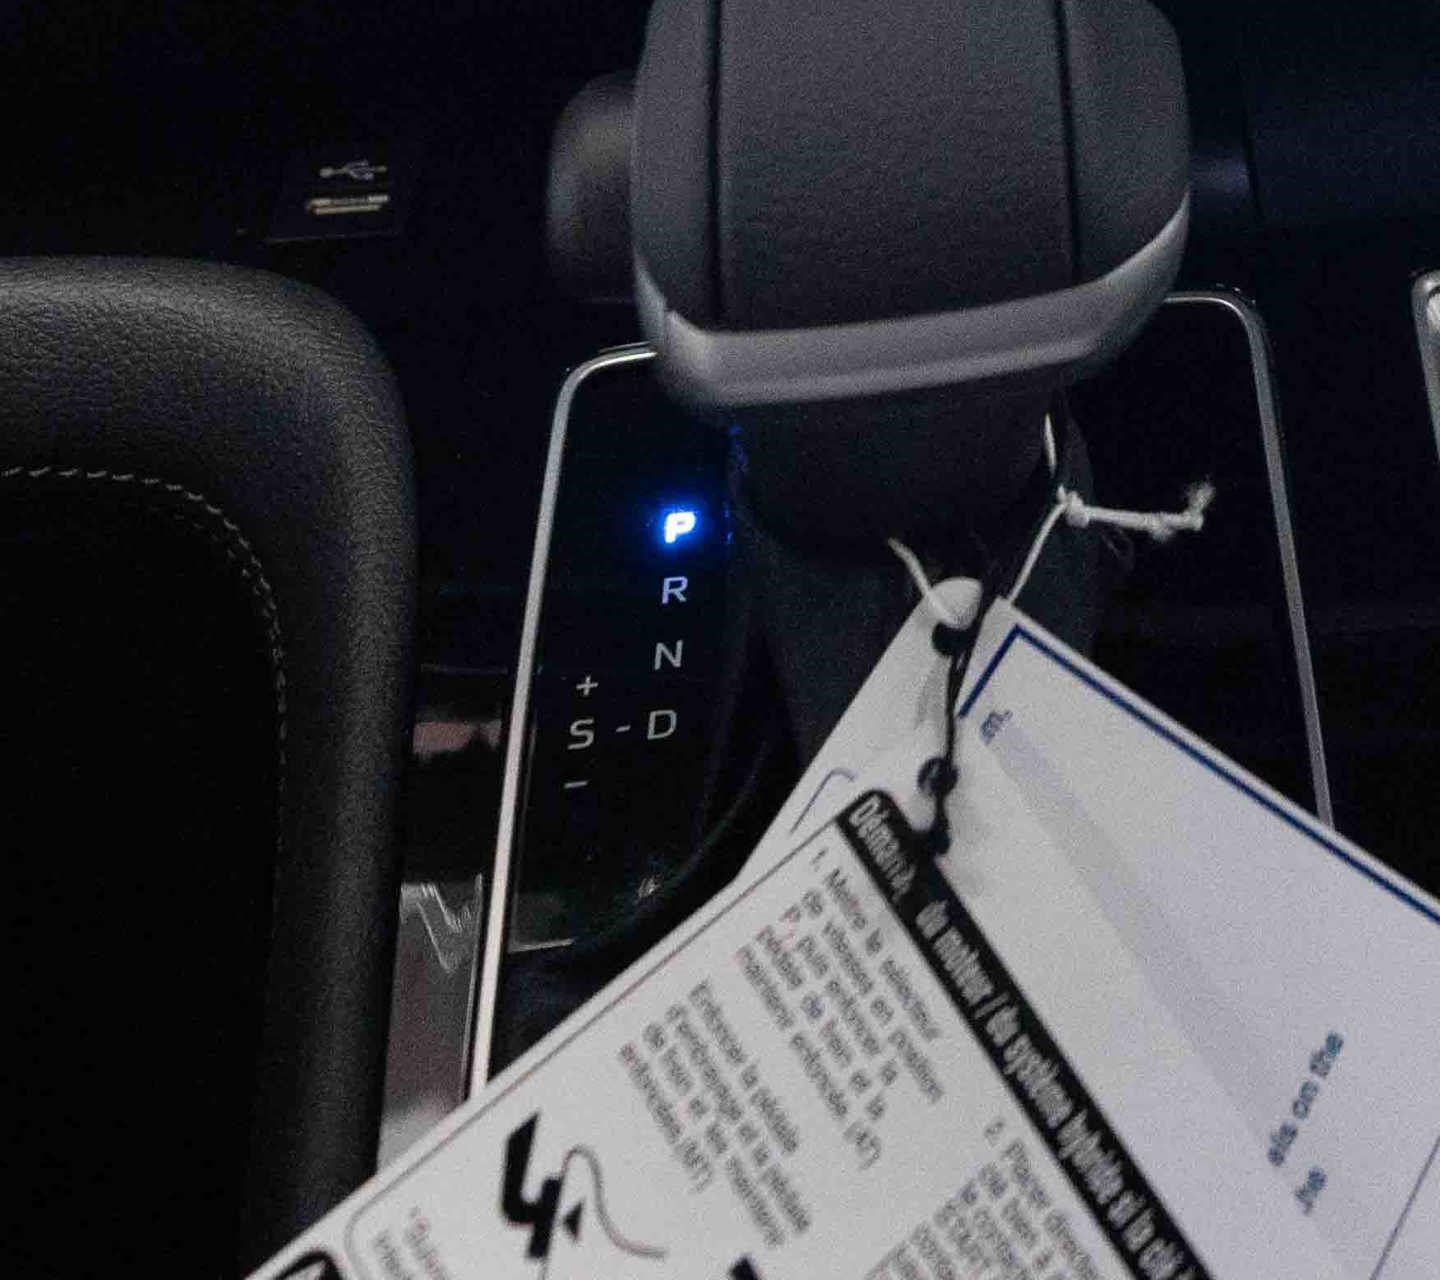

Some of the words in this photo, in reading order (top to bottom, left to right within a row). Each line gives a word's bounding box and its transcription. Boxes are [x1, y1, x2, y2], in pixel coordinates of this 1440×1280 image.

[663, 510, 697, 545] P
[662, 576, 689, 604] R
[654, 640, 684, 671] N
[567, 718, 595, 750] S
[647, 709, 677, 741] D
